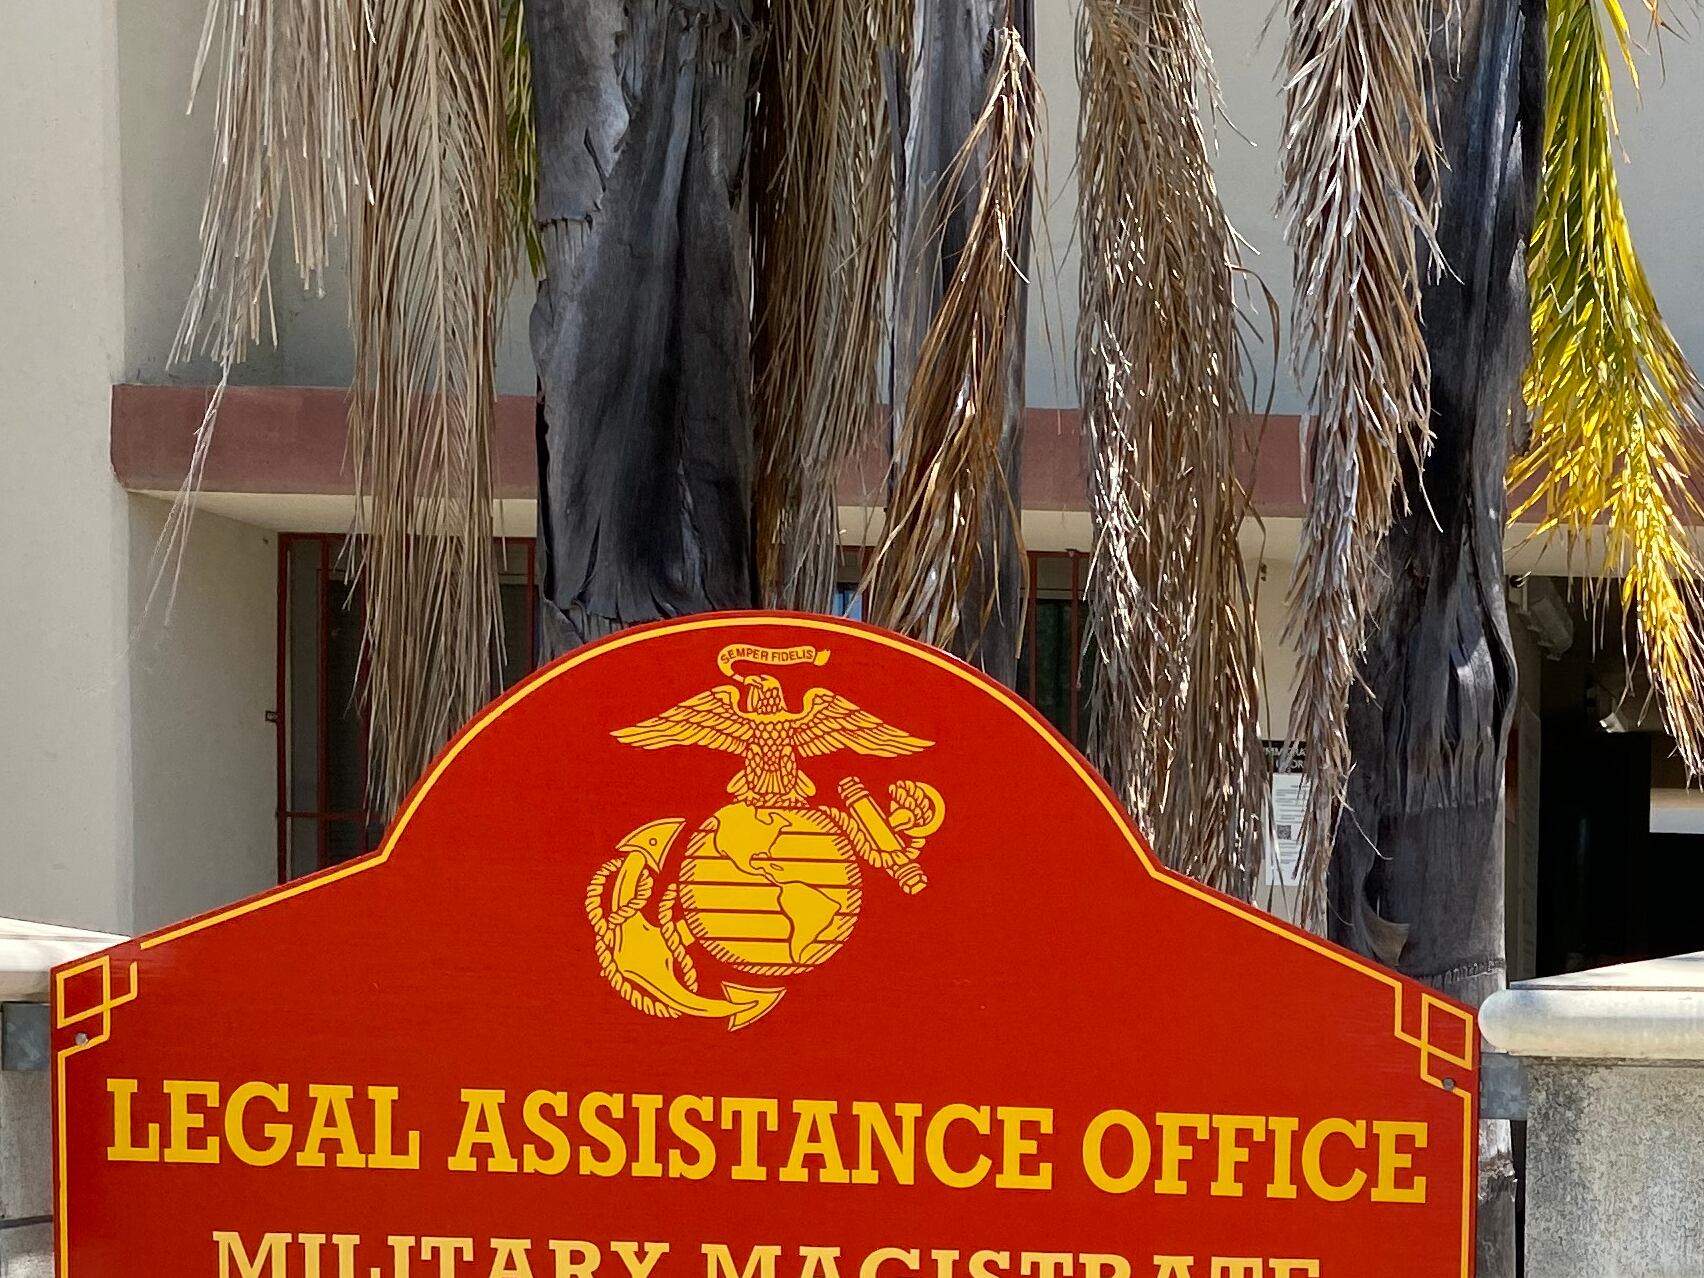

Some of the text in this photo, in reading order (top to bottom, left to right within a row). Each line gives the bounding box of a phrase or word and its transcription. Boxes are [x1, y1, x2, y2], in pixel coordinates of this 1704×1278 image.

[720, 648, 814, 664] SEMPER FIDELIS
[107, 1079, 1427, 1203] LEGAL ASSISTANCE OFFICE
